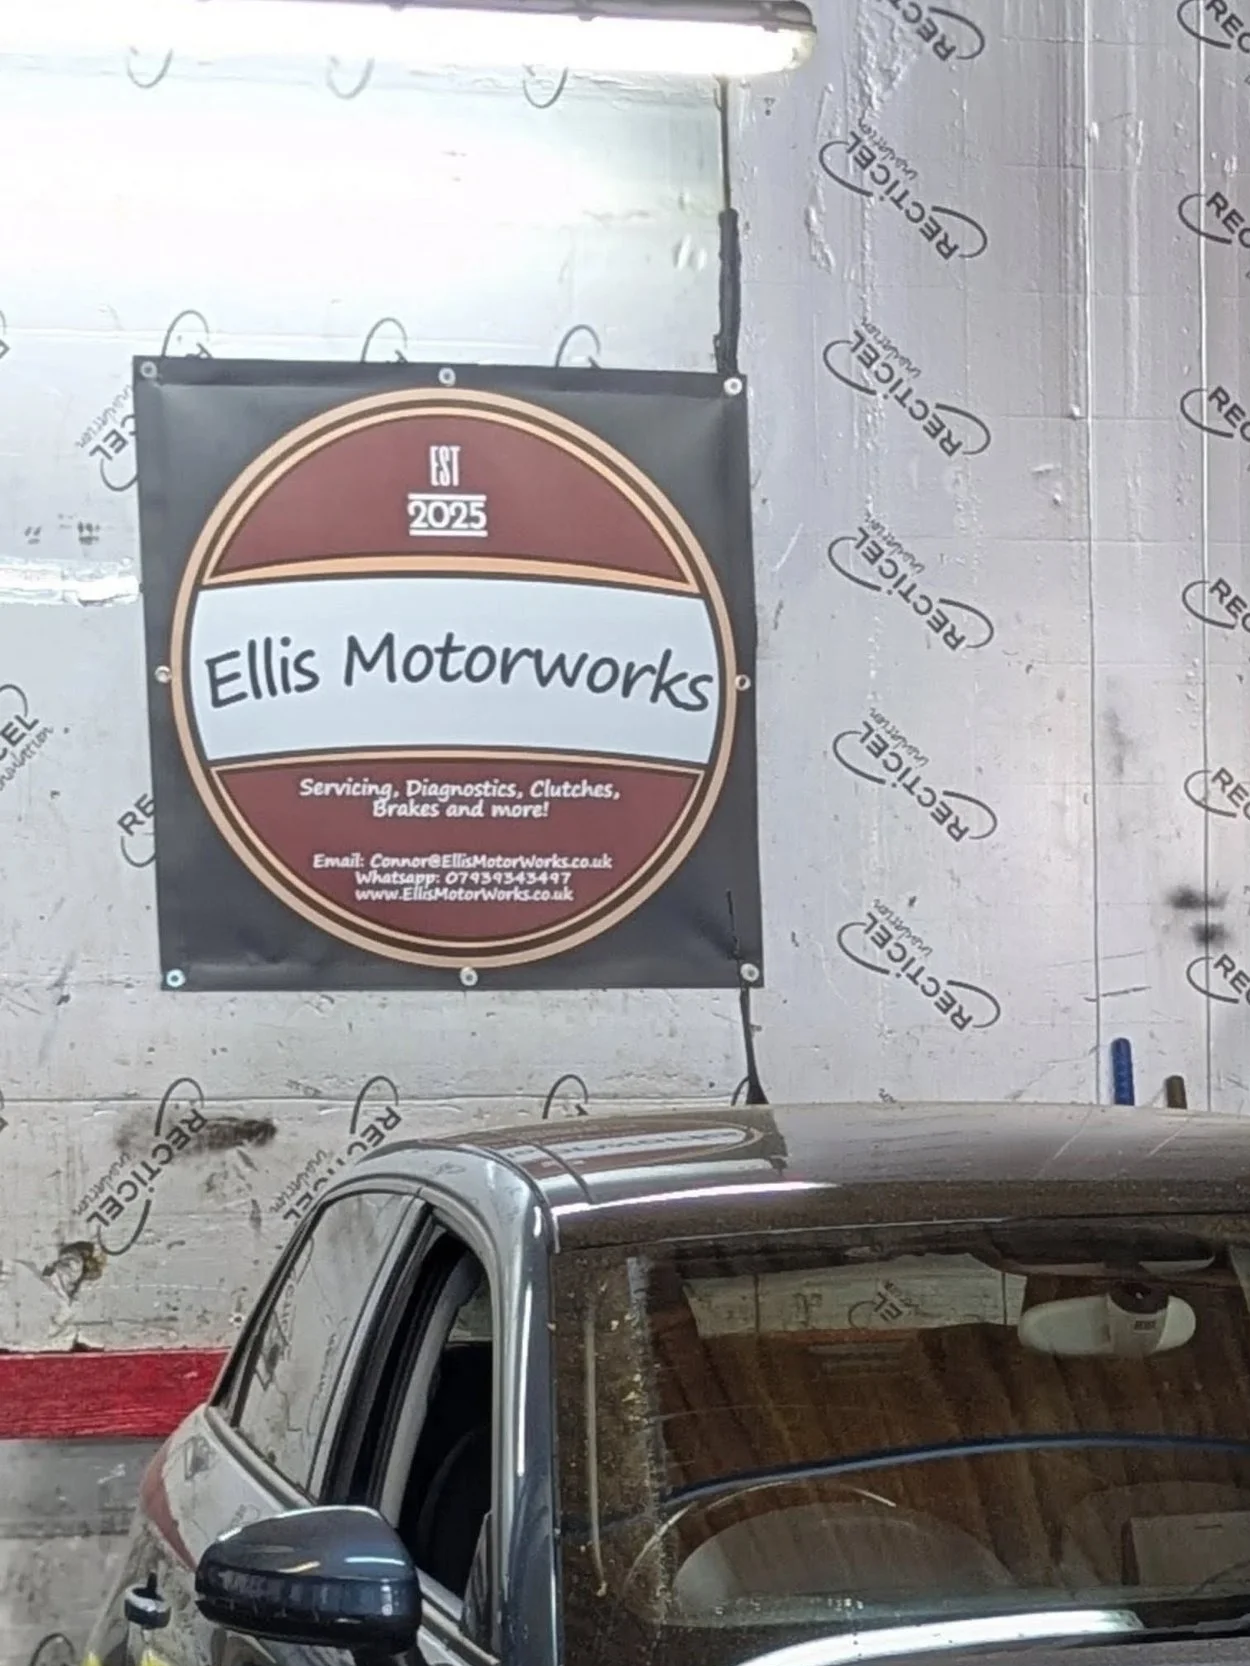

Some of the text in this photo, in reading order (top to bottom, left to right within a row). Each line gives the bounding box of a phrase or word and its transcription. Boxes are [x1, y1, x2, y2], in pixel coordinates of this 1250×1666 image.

[846, 131, 960, 260] RECTICEL
[851, 329, 963, 457] RECTICEL
[429, 445, 460, 487] EST
[408, 500, 487, 530] 2025
[854, 526, 966, 651] RECTICEL
[205, 632, 714, 712] Ellis Motorworks
[299, 778, 620, 802] Servicing, Diagnostics, Clutches,
[372, 800, 550, 819] Brakes and more!
[860, 720, 970, 842] RECTICEL
[313, 852, 365, 869] Email:
[355, 869, 440, 888] Whatsapp:
[863, 912, 973, 1031] RECTICEL
